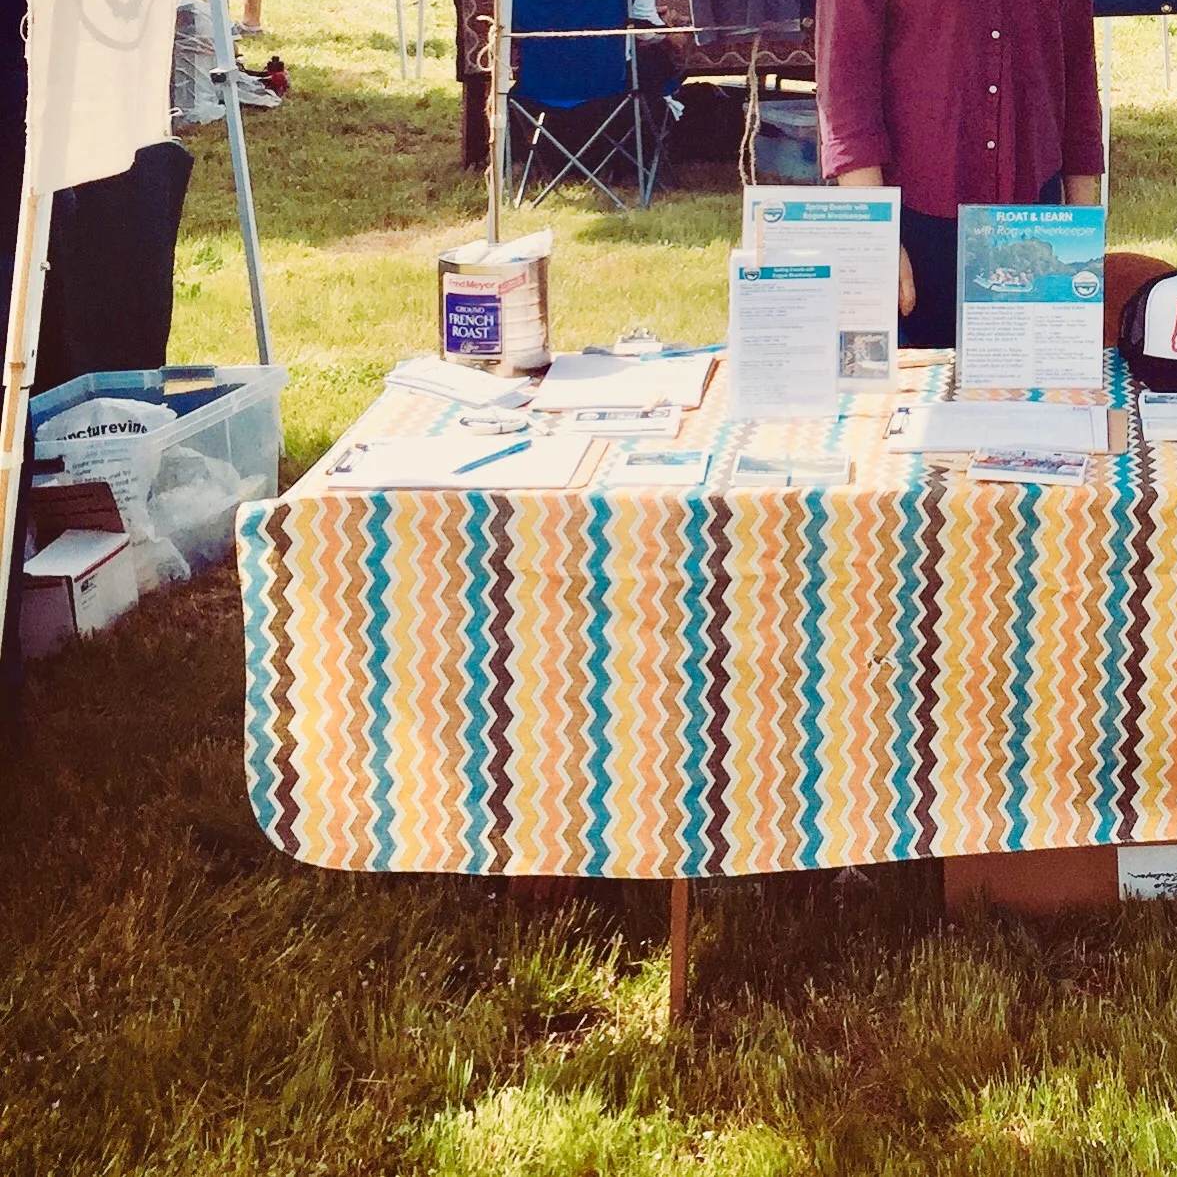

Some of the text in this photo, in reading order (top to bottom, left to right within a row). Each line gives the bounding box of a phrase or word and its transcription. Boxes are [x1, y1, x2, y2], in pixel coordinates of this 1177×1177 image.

[996, 211, 1073, 222] FLOAT & LEARN
[973, 225, 1096, 237] with Rogue Riverkeeper
[449, 313, 494, 326] FRENCH
[452, 326, 490, 339] ROAST
